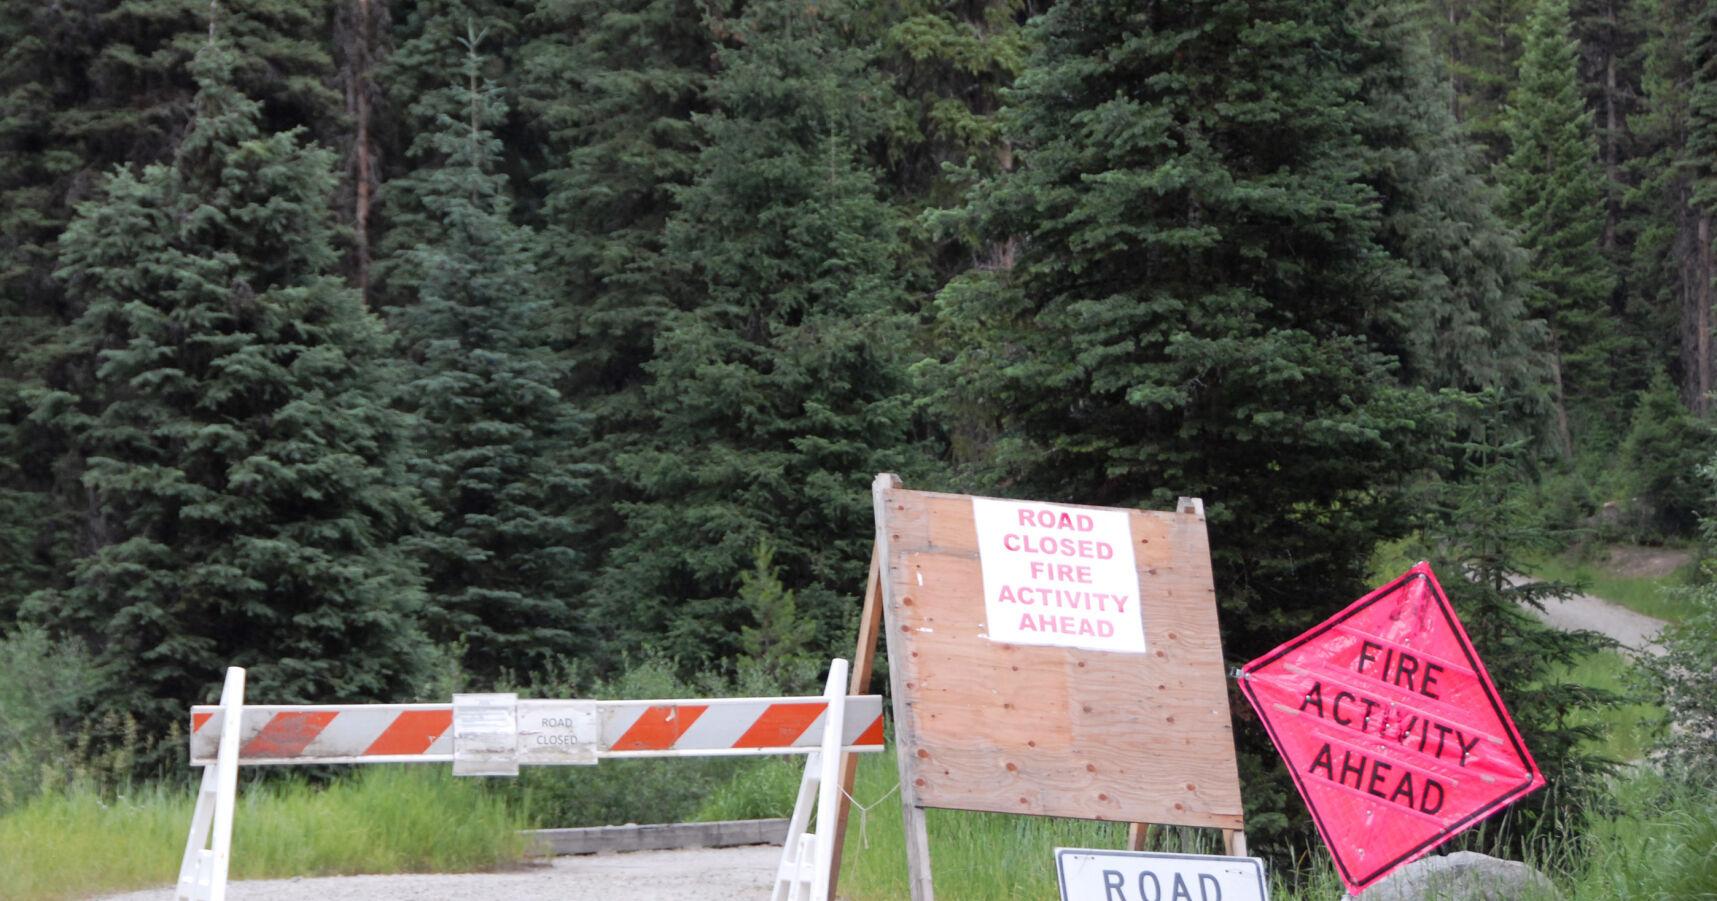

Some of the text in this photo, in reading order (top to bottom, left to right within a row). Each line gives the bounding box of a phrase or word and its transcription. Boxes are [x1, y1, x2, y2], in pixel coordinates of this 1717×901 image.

[1018, 508, 1094, 532] ROAD
[1003, 533, 1114, 560] CLOSED
[1030, 561, 1093, 584] FIRE
[998, 585, 1129, 613] ACTIVITY
[1019, 613, 1115, 638] AHEAD
[1357, 640, 1444, 700] FIRE
[541, 718, 573, 728] ROAD
[1299, 681, 1480, 767] ACTIVITY
[537, 735, 578, 745] CLOSED
[1308, 743, 1445, 815] AHEAD
[1103, 870, 1222, 901] ROAD
